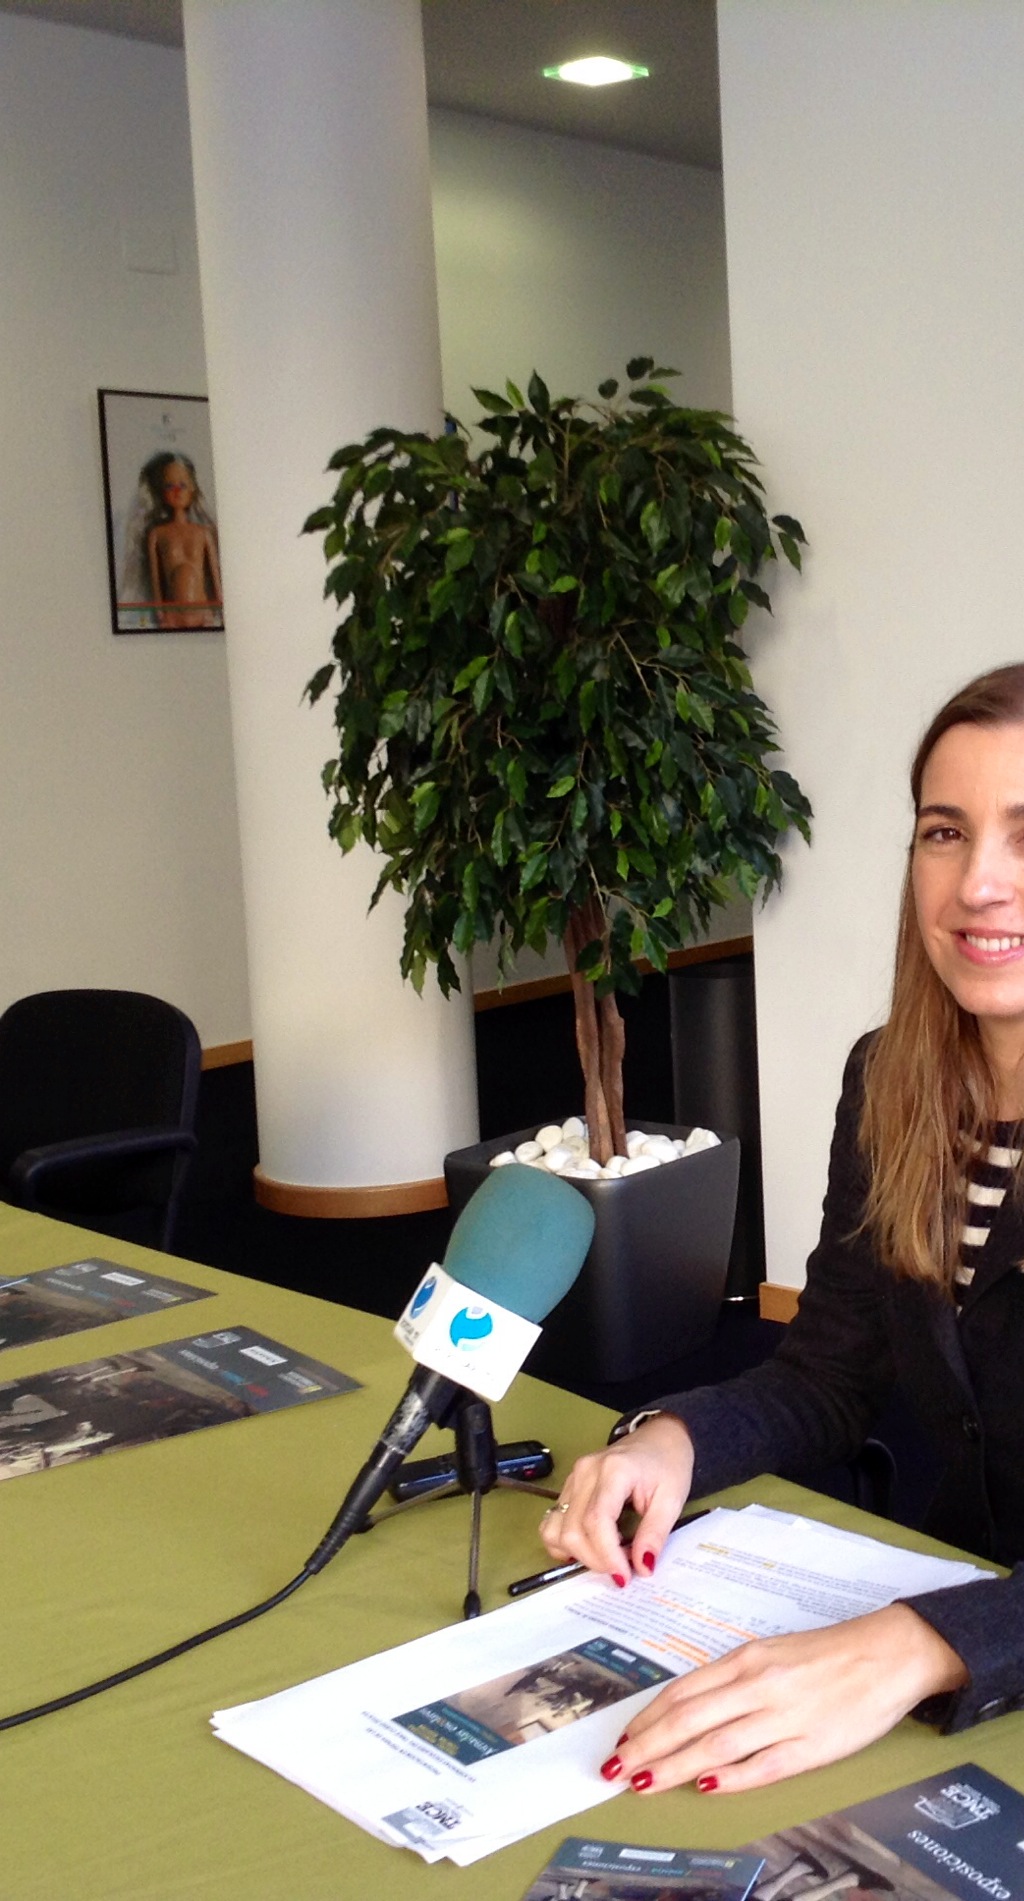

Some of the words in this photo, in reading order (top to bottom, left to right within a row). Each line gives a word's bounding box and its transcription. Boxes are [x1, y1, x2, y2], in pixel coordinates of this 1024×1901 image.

[415, 1801, 461, 1830] TMCE
[940, 1784, 994, 1820] TMCE
[907, 1829, 1012, 1899] exposiciones
